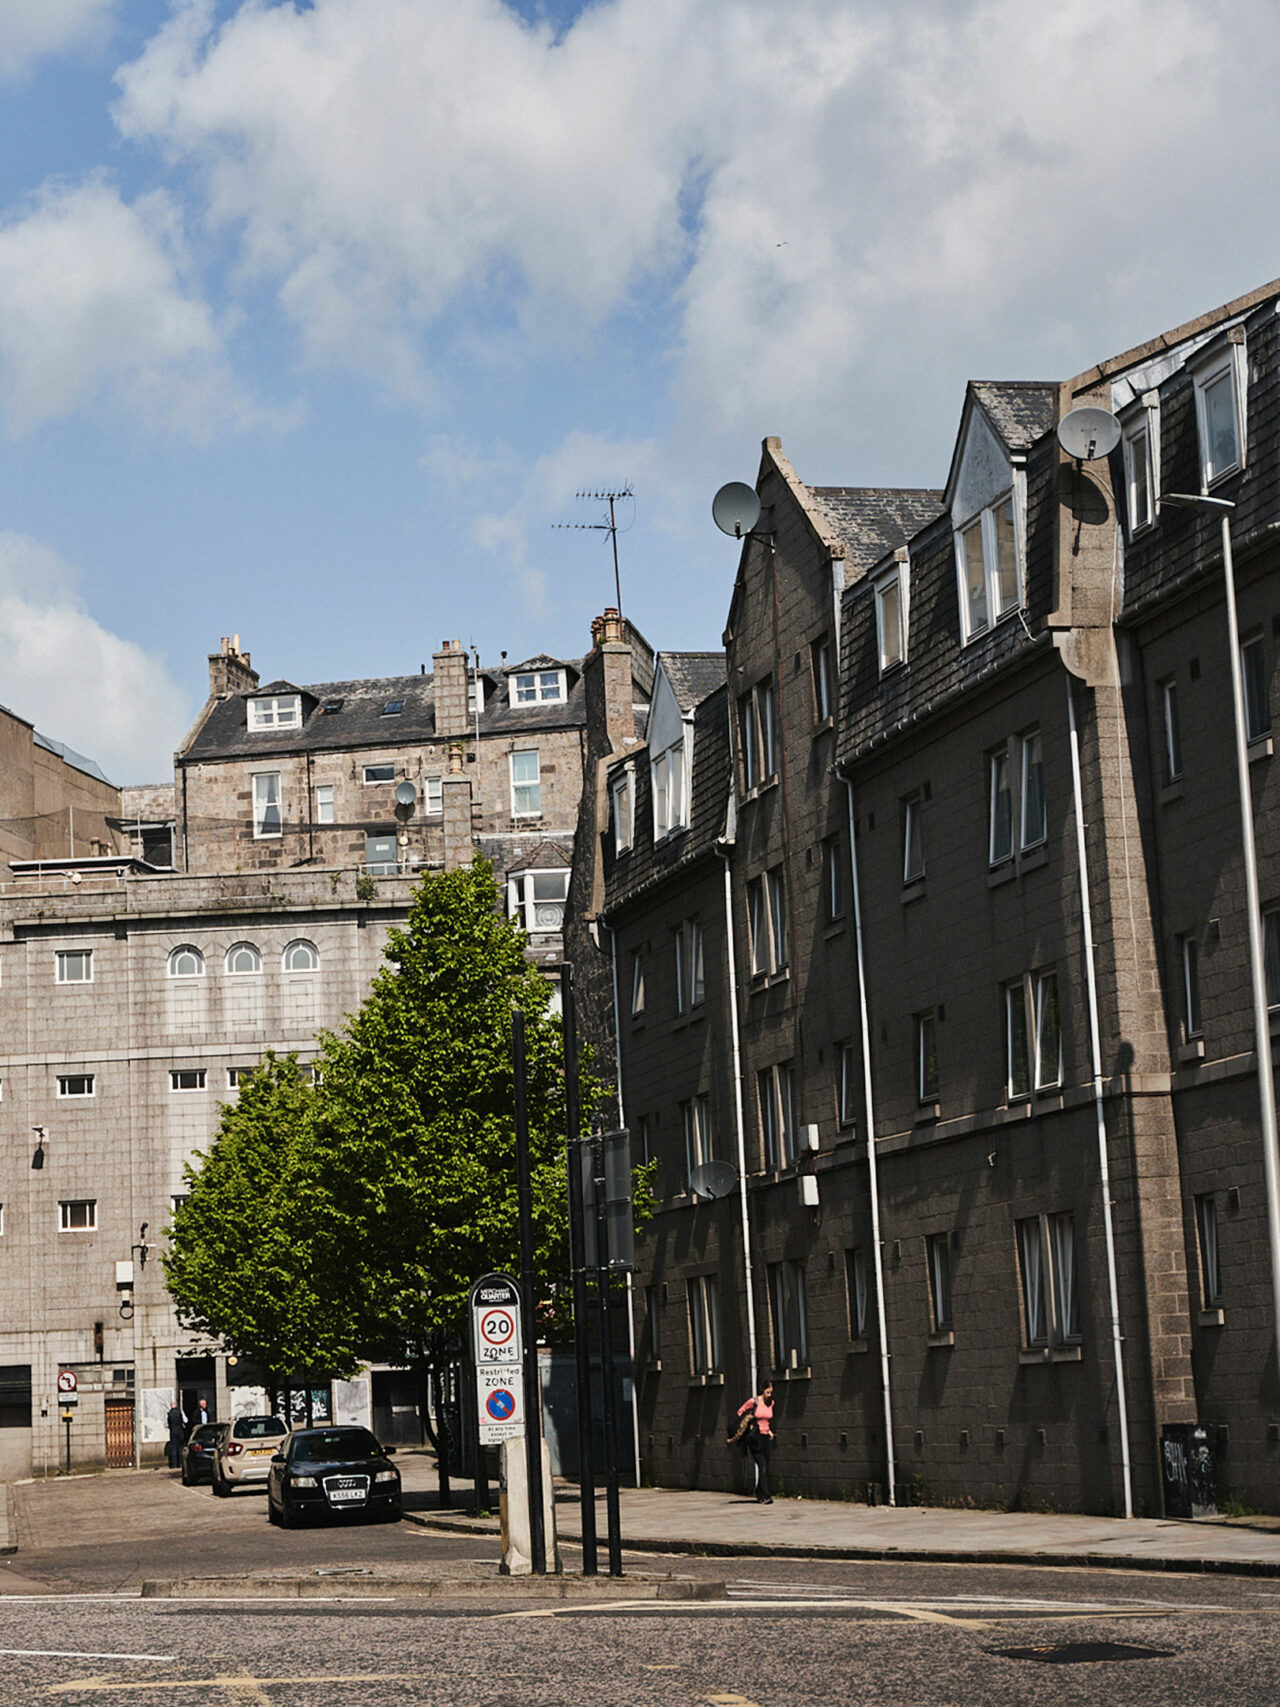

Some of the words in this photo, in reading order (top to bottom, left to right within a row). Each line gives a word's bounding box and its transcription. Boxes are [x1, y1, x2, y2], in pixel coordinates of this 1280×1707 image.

[487, 1320, 509, 1334] 20
[483, 1347, 514, 1357] ZONE
[485, 1377, 514, 1387] ZONE
